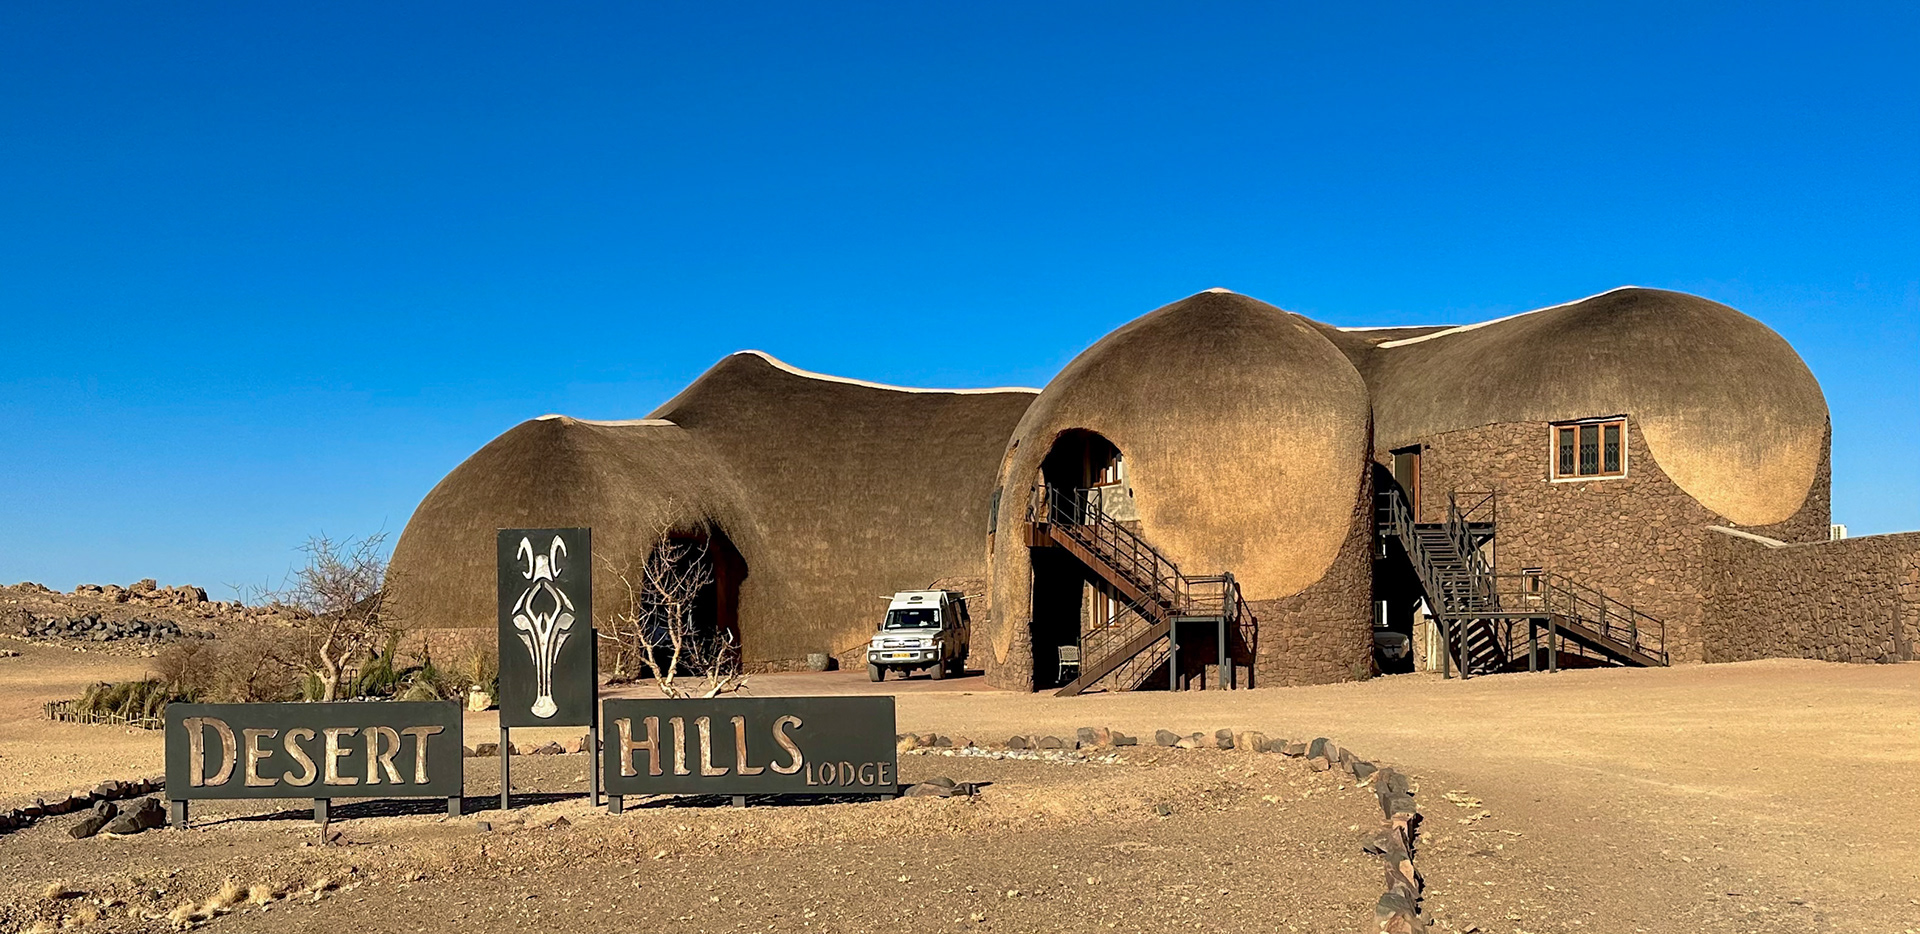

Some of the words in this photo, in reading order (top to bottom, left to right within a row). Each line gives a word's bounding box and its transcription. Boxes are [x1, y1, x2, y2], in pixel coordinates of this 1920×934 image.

[182, 716, 446, 787] DESERT
[613, 714, 804, 777] HILLS
[805, 760, 892, 787] LODGE
